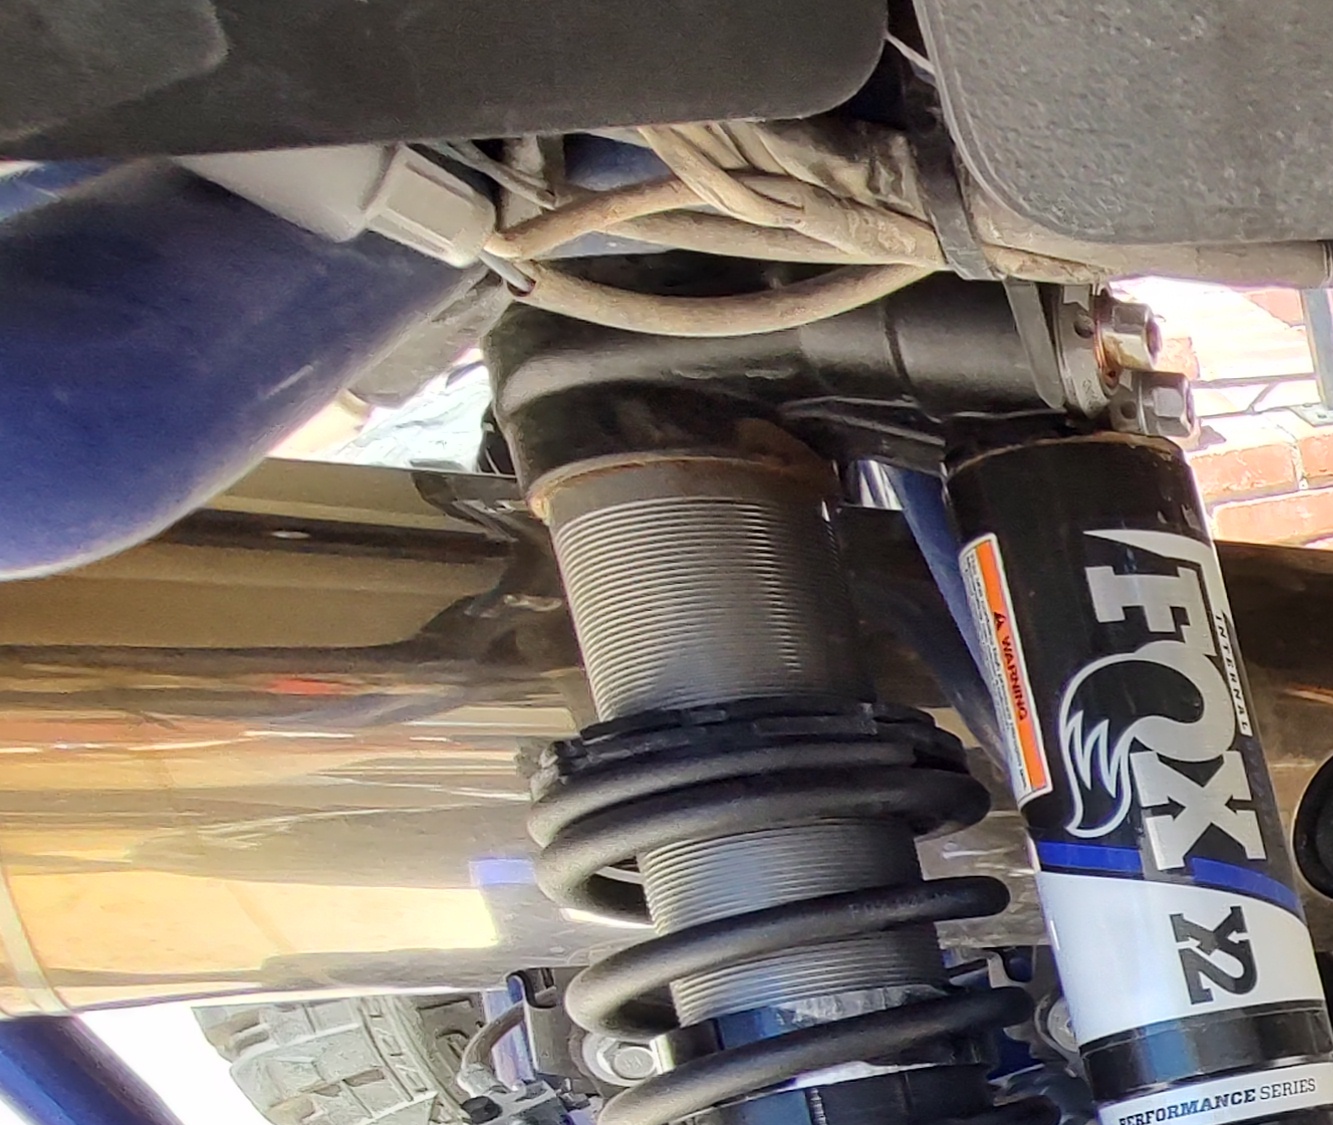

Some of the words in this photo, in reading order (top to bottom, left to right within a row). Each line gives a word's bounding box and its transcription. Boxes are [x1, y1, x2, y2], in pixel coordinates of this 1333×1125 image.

[1001, 635, 1028, 721] WARNING
[1059, 529, 1267, 871] FOX
[1214, 613, 1249, 731] INTERNAL
[1169, 905, 1258, 1005] X2
[1259, 1077, 1317, 1101] SERIES
